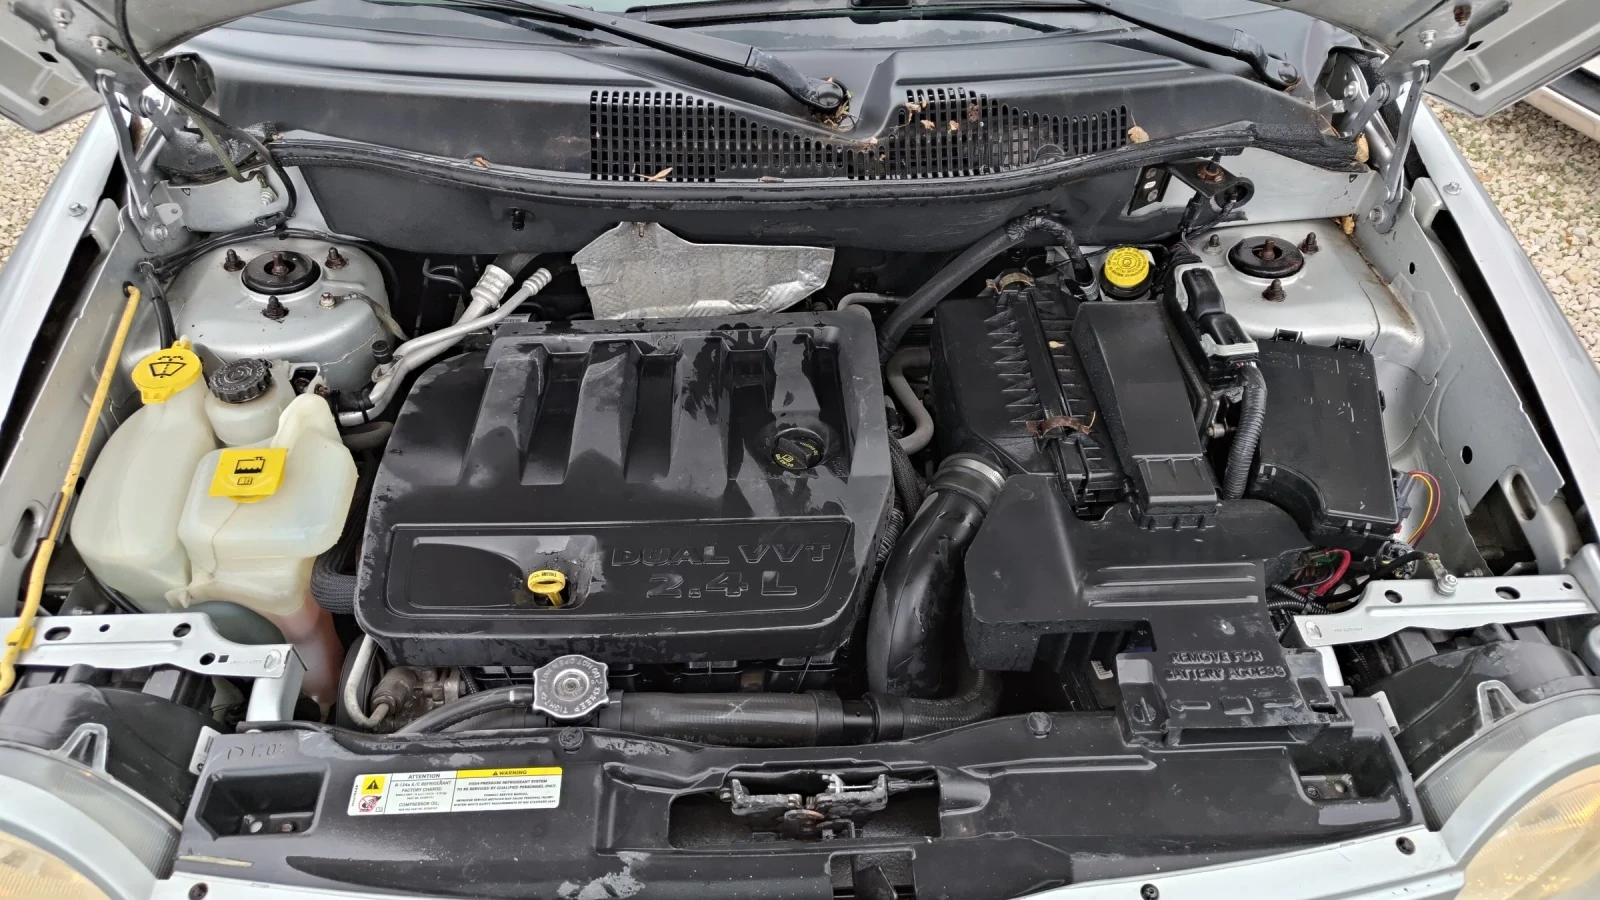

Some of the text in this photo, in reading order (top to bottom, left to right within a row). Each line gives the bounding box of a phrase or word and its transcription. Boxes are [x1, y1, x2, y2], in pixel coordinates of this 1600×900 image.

[612, 543, 831, 567] DUAL VVT
[1168, 650, 1264, 665] REMOVE FOR
[1163, 665, 1287, 682] BATTERY ACCESS
[544, 699, 568, 714] TIGHT
